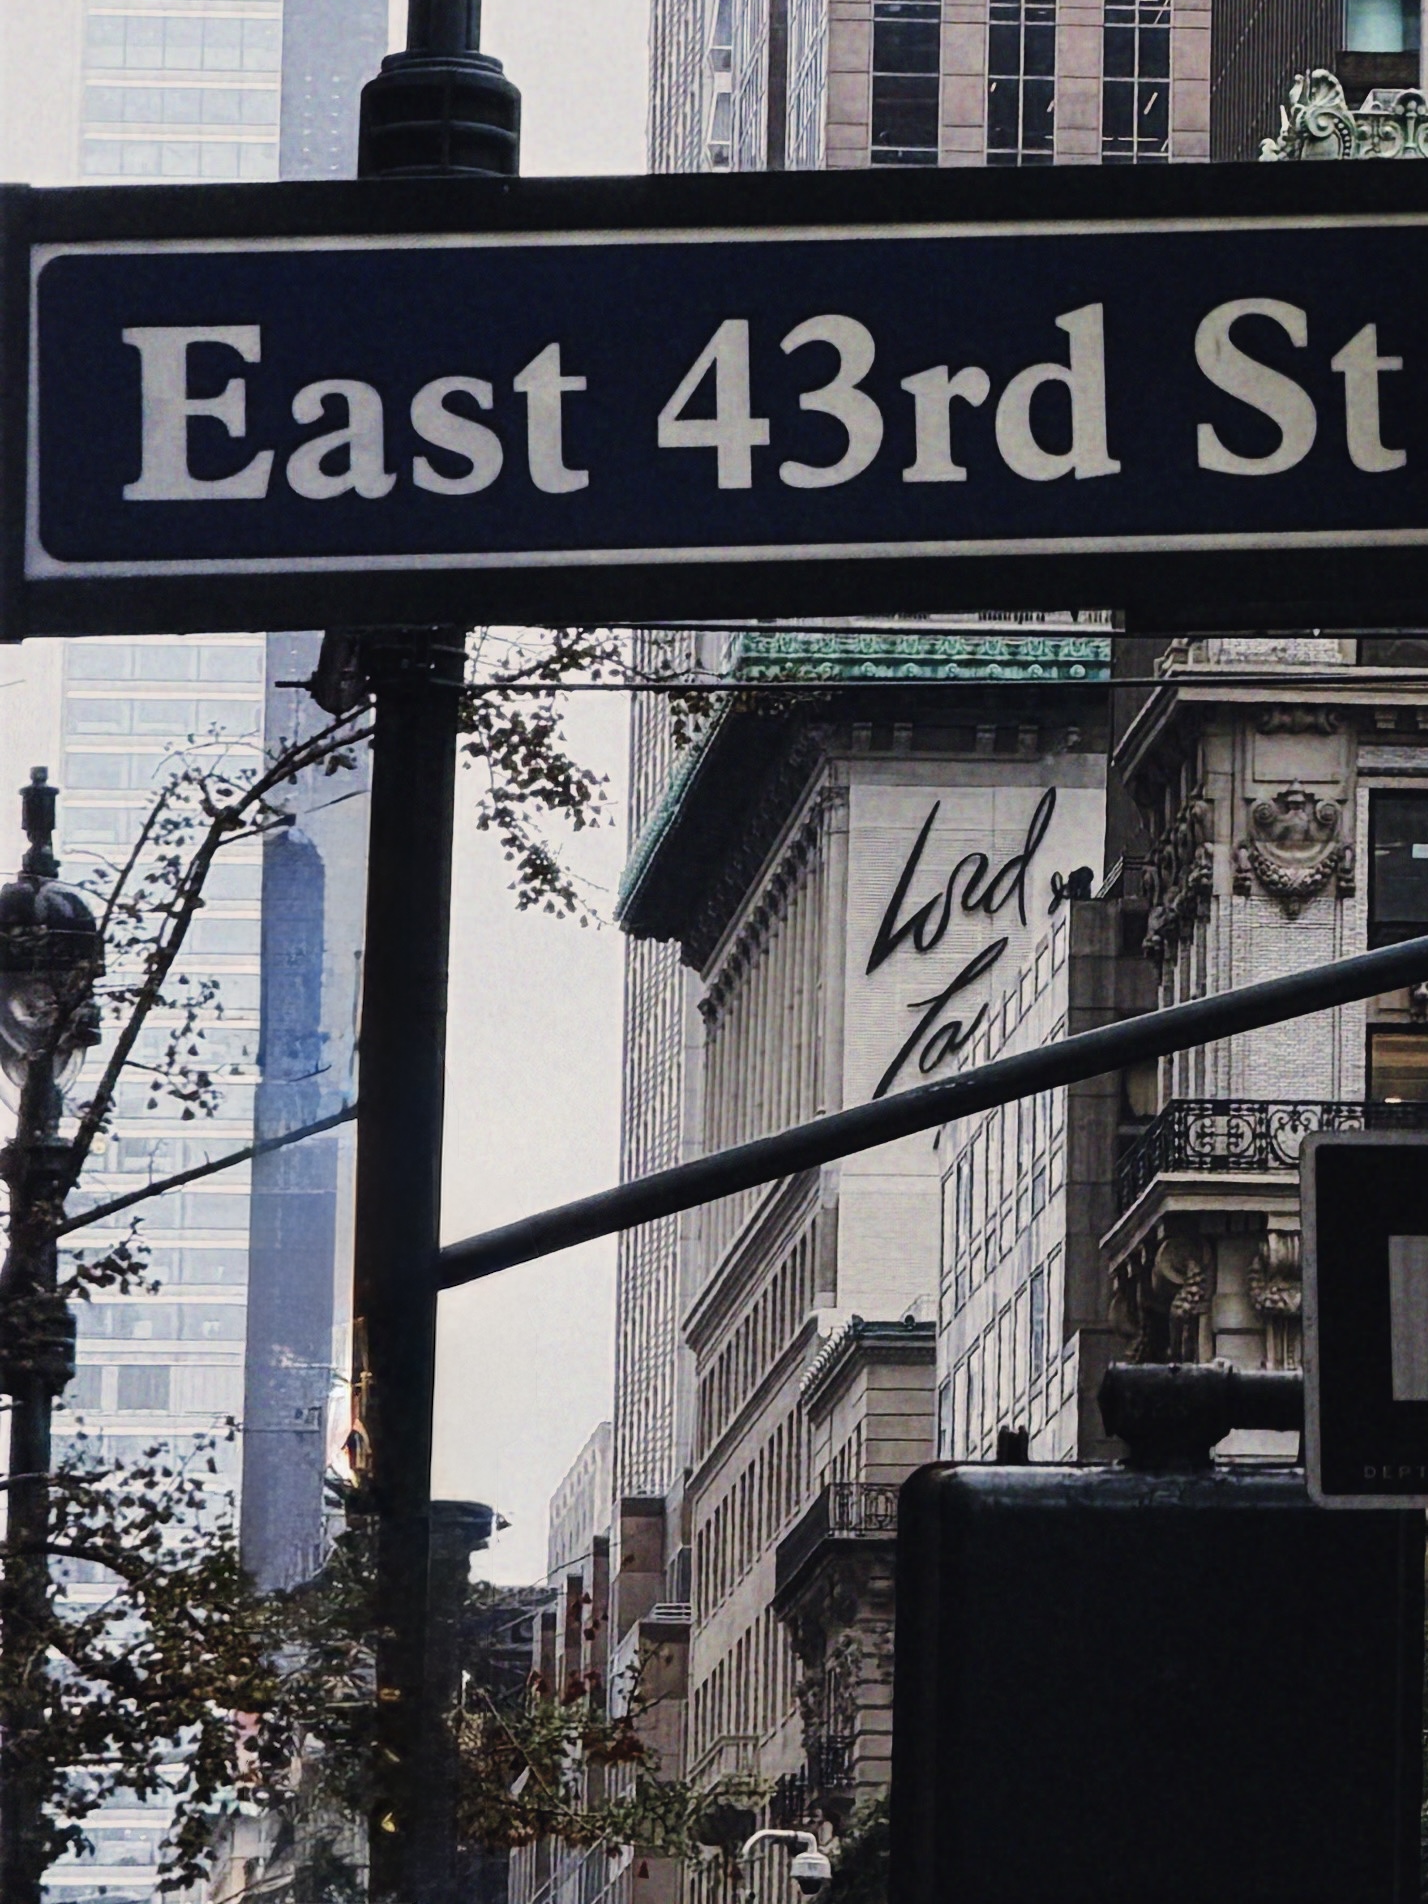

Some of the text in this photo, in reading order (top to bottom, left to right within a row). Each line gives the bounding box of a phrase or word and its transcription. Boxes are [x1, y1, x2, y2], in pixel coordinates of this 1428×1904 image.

[122, 297, 1407, 501] East 43rd St
[866, 785, 1056, 976] Lord
[1362, 1465, 1428, 1481] DEPT
